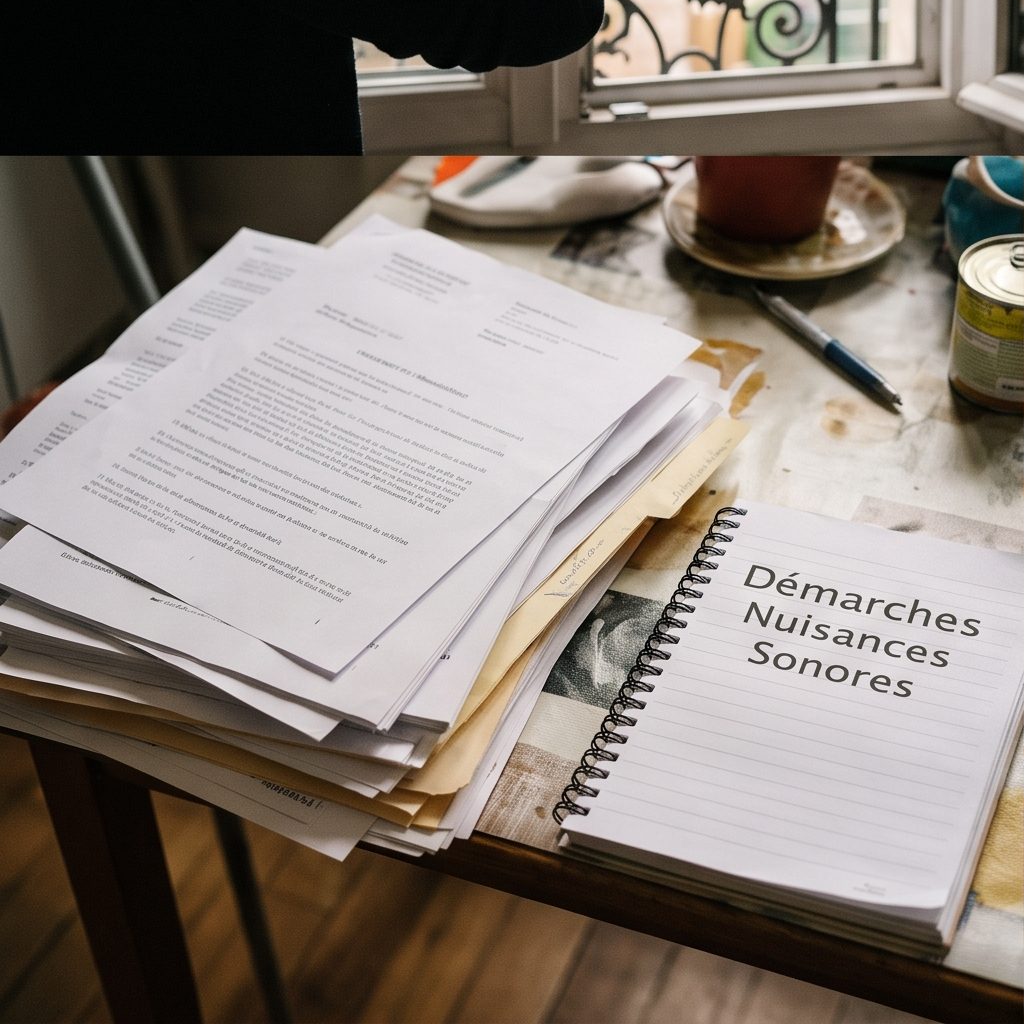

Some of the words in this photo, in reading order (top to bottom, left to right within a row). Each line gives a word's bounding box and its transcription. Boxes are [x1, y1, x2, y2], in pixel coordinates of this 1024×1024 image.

[743, 564, 982, 637] Démarches
[743, 601, 950, 668] Nuisances
[747, 641, 914, 698] Sonores
